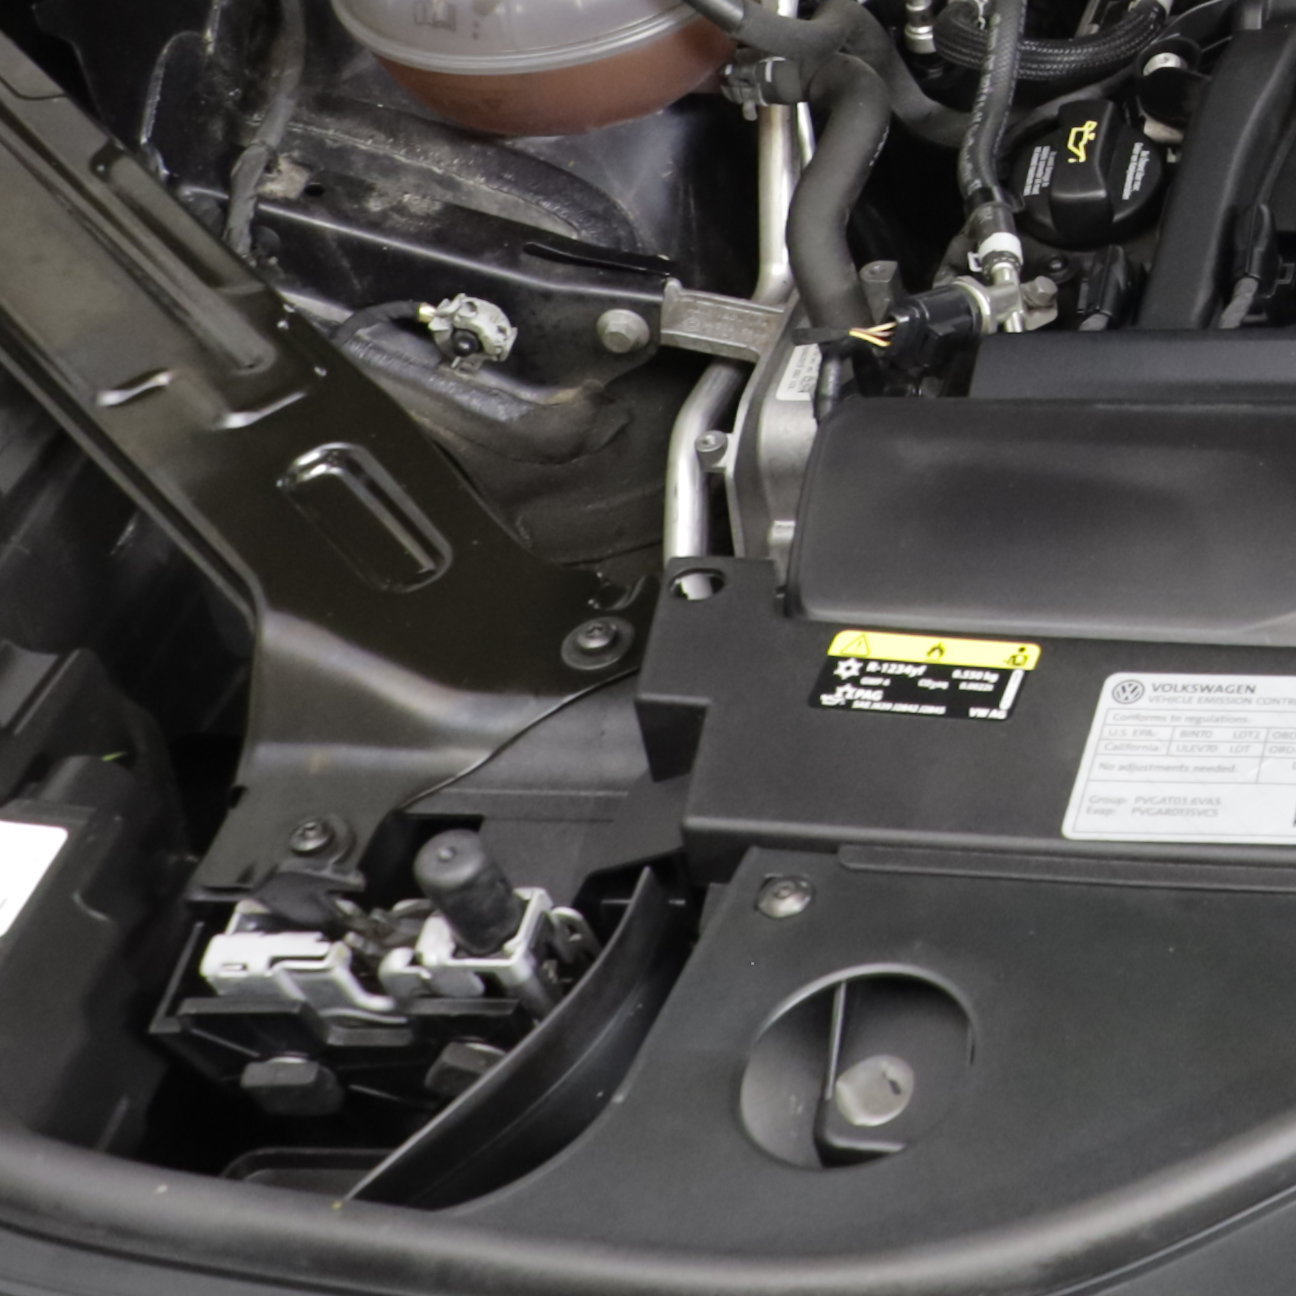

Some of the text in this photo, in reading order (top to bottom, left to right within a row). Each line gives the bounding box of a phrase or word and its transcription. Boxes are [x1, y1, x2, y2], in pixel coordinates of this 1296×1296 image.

[1151, 683, 1257, 695] VOLKSWAGEN
[1148, 695, 1194, 705] VEHICLE
[1197, 696, 1253, 706] EMISSION
[1112, 713, 1167, 723] Conforms
[1099, 762, 1116, 772] No
[1117, 763, 1190, 774] adjustments
